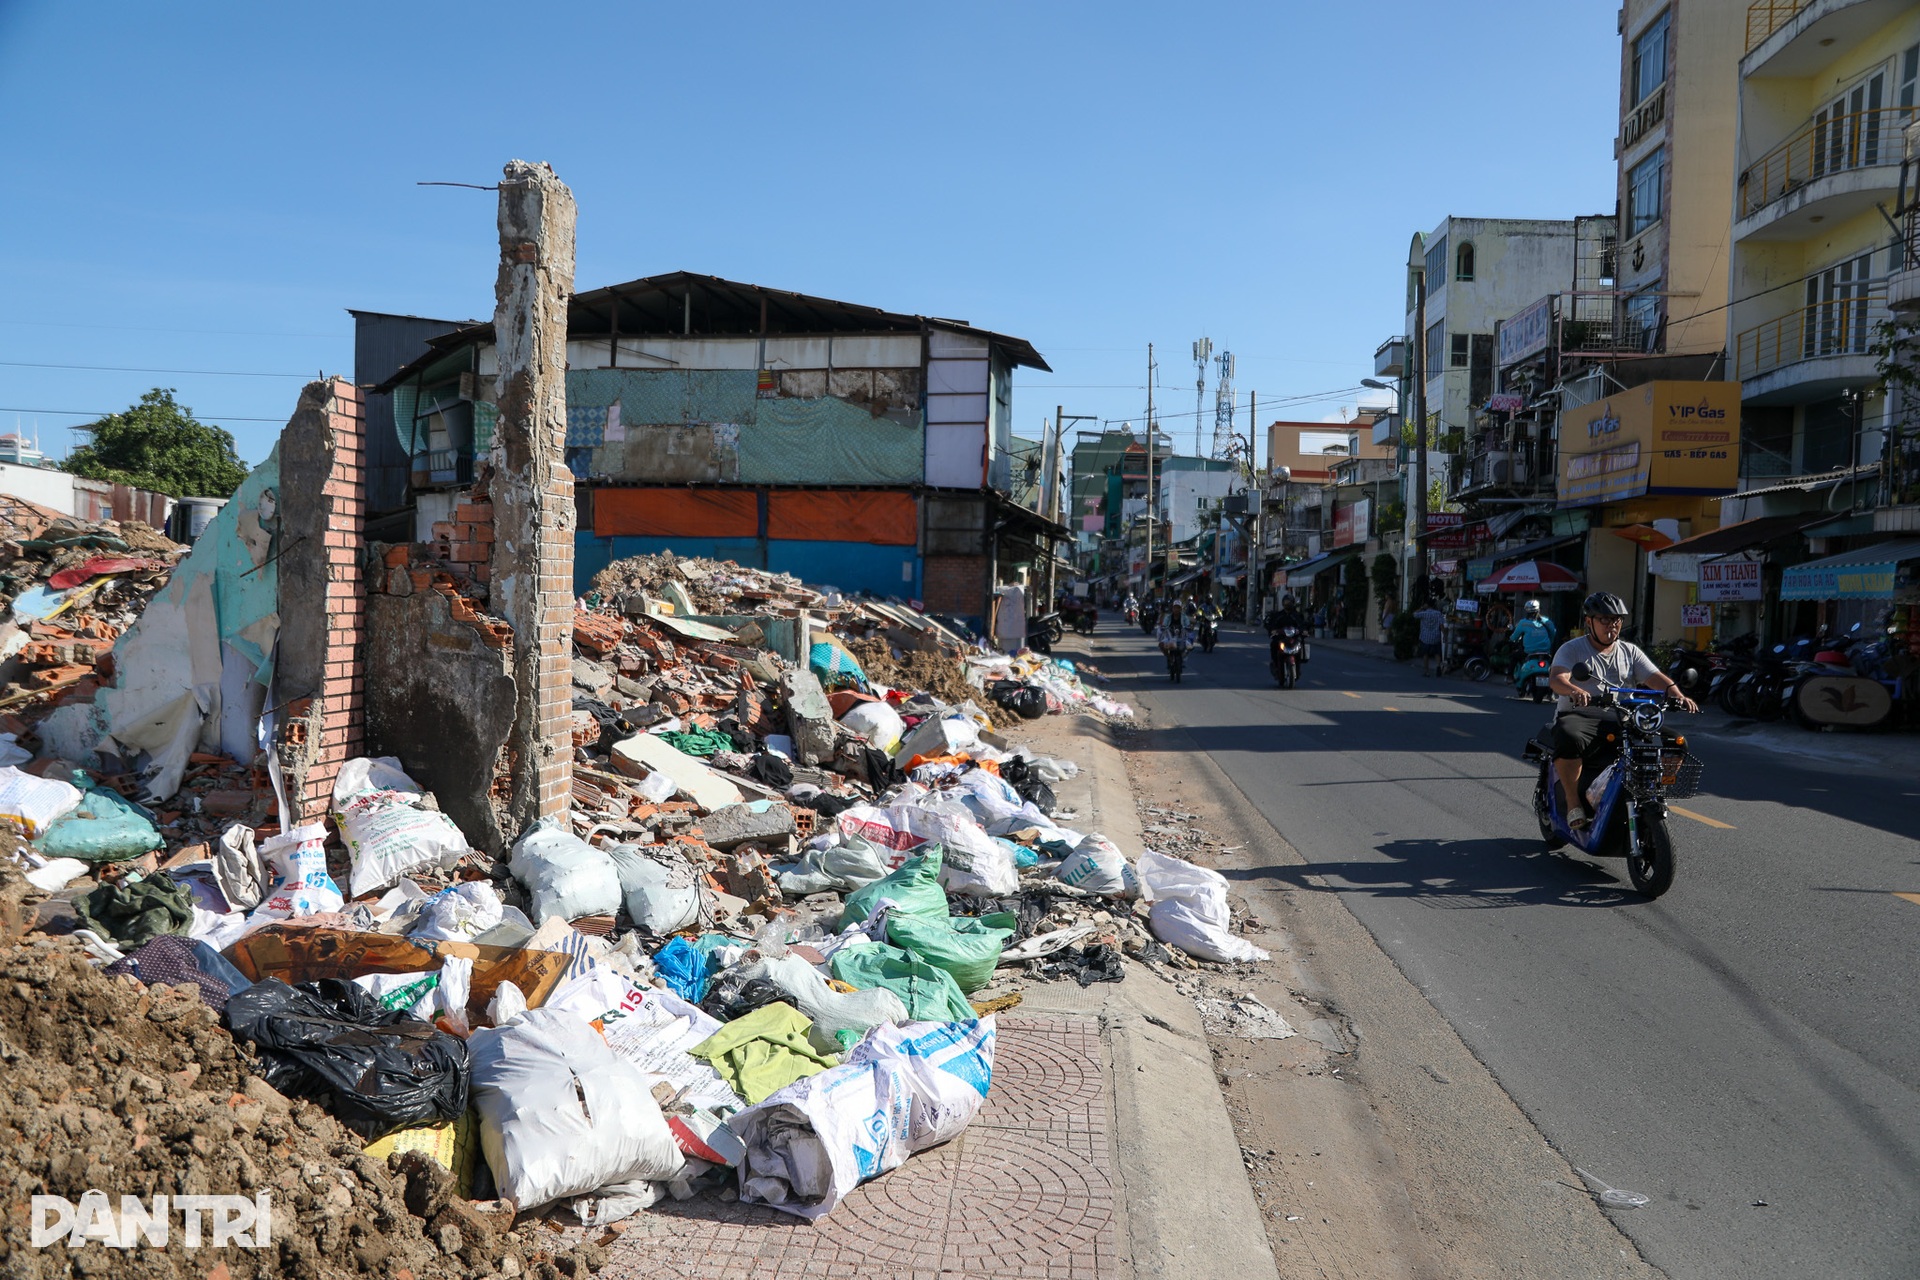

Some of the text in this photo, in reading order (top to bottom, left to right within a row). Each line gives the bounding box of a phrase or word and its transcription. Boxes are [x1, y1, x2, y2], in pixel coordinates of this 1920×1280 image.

[1669, 405, 1725, 418] VIP Gas
[1664, 450, 1681, 458] GAS
[1690, 448, 1707, 459] BẾP
[1427, 515, 1462, 524] MOTUL
[1703, 565, 1722, 581] KIM
[1724, 564, 1758, 580] THANH
[1065, 857, 1098, 886] VILLA
